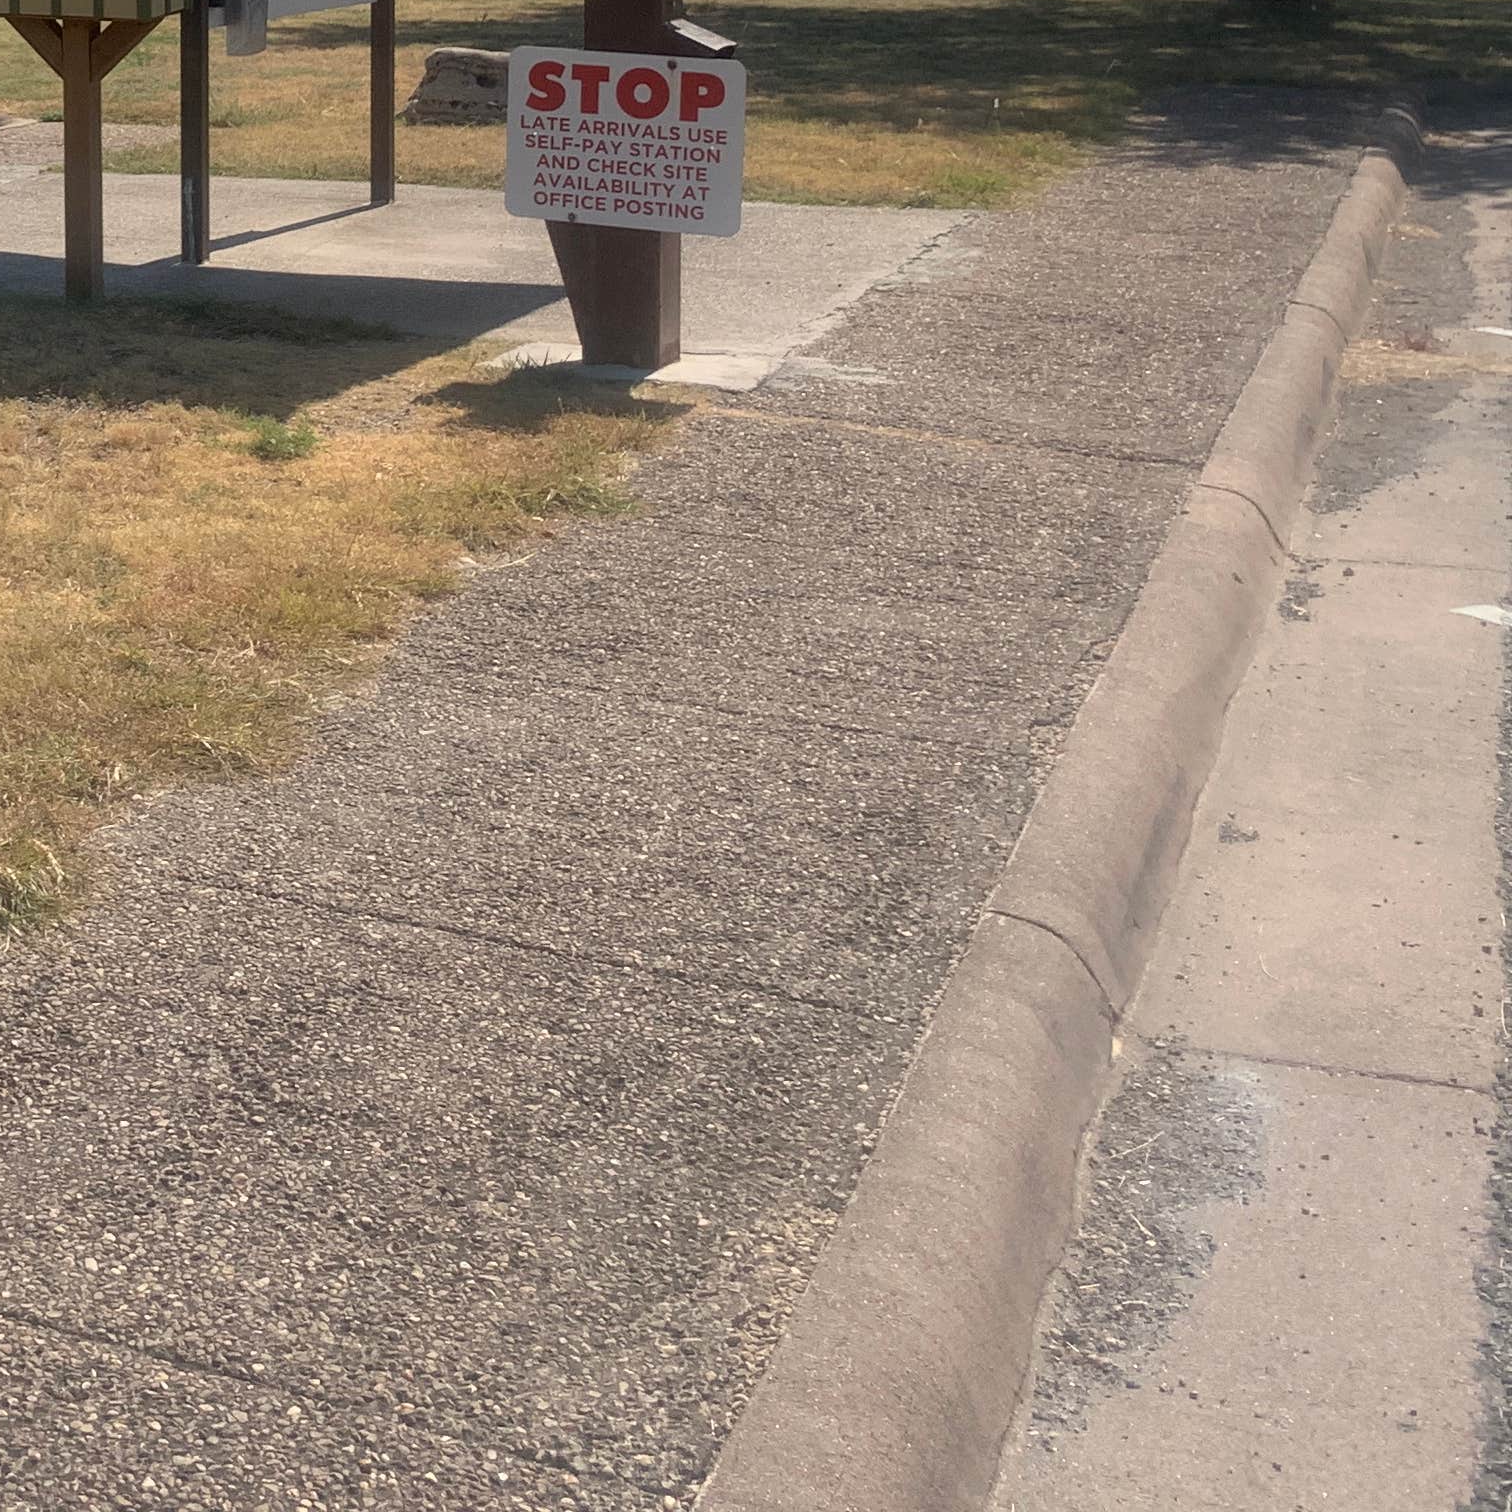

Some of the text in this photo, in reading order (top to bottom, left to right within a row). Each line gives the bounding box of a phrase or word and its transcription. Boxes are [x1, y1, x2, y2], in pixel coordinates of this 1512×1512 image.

[525, 61, 725, 122] STOP
[520, 115, 728, 145] LATE ARRIVALS USE
[525, 134, 720, 163] SELF-PAY STATION
[536, 154, 707, 182] AND CHECK SITE
[533, 172, 710, 201] AVAILABILITY AT
[534, 191, 705, 220] OFFICE POSTING
